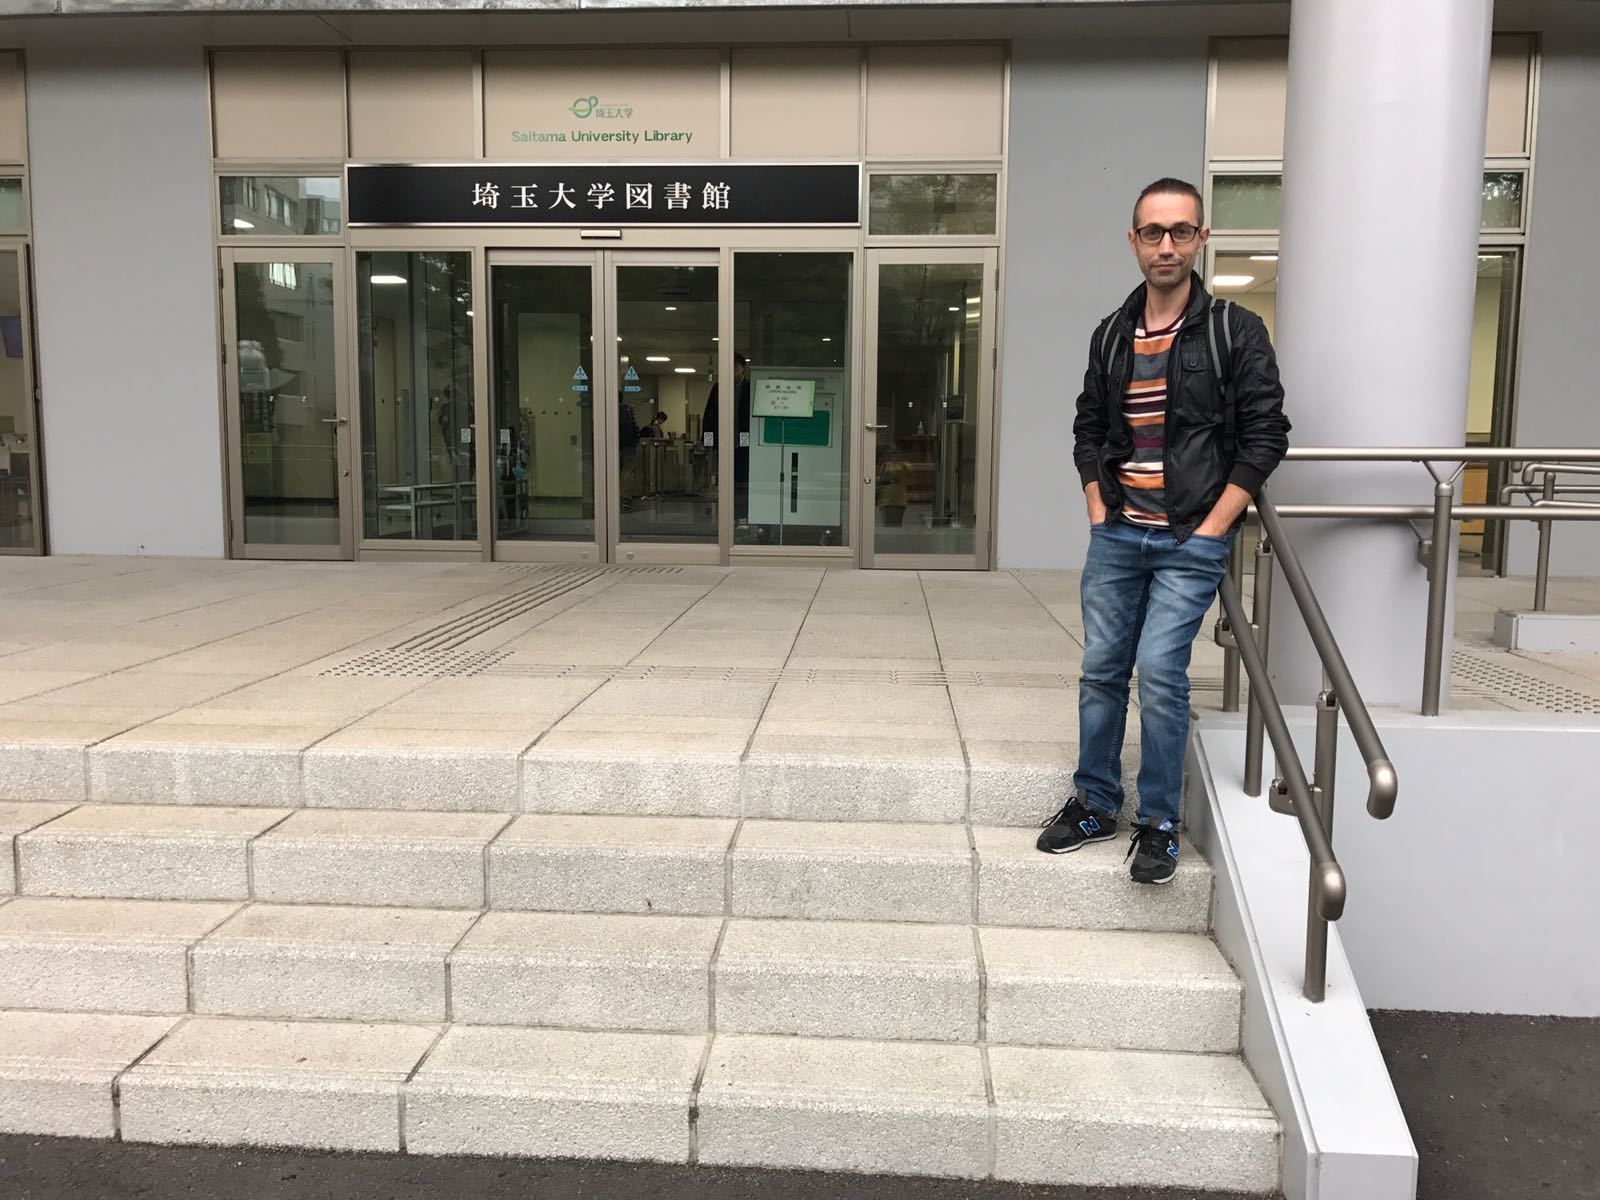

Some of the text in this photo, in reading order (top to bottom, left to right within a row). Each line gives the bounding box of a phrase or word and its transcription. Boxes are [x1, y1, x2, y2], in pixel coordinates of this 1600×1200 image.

[595, 107, 633, 119] 埼玉大学
[512, 130, 693, 144] Saitama University Library
[471, 181, 731, 210] 埼玉大学図書館
[1079, 815, 1100, 837] N
